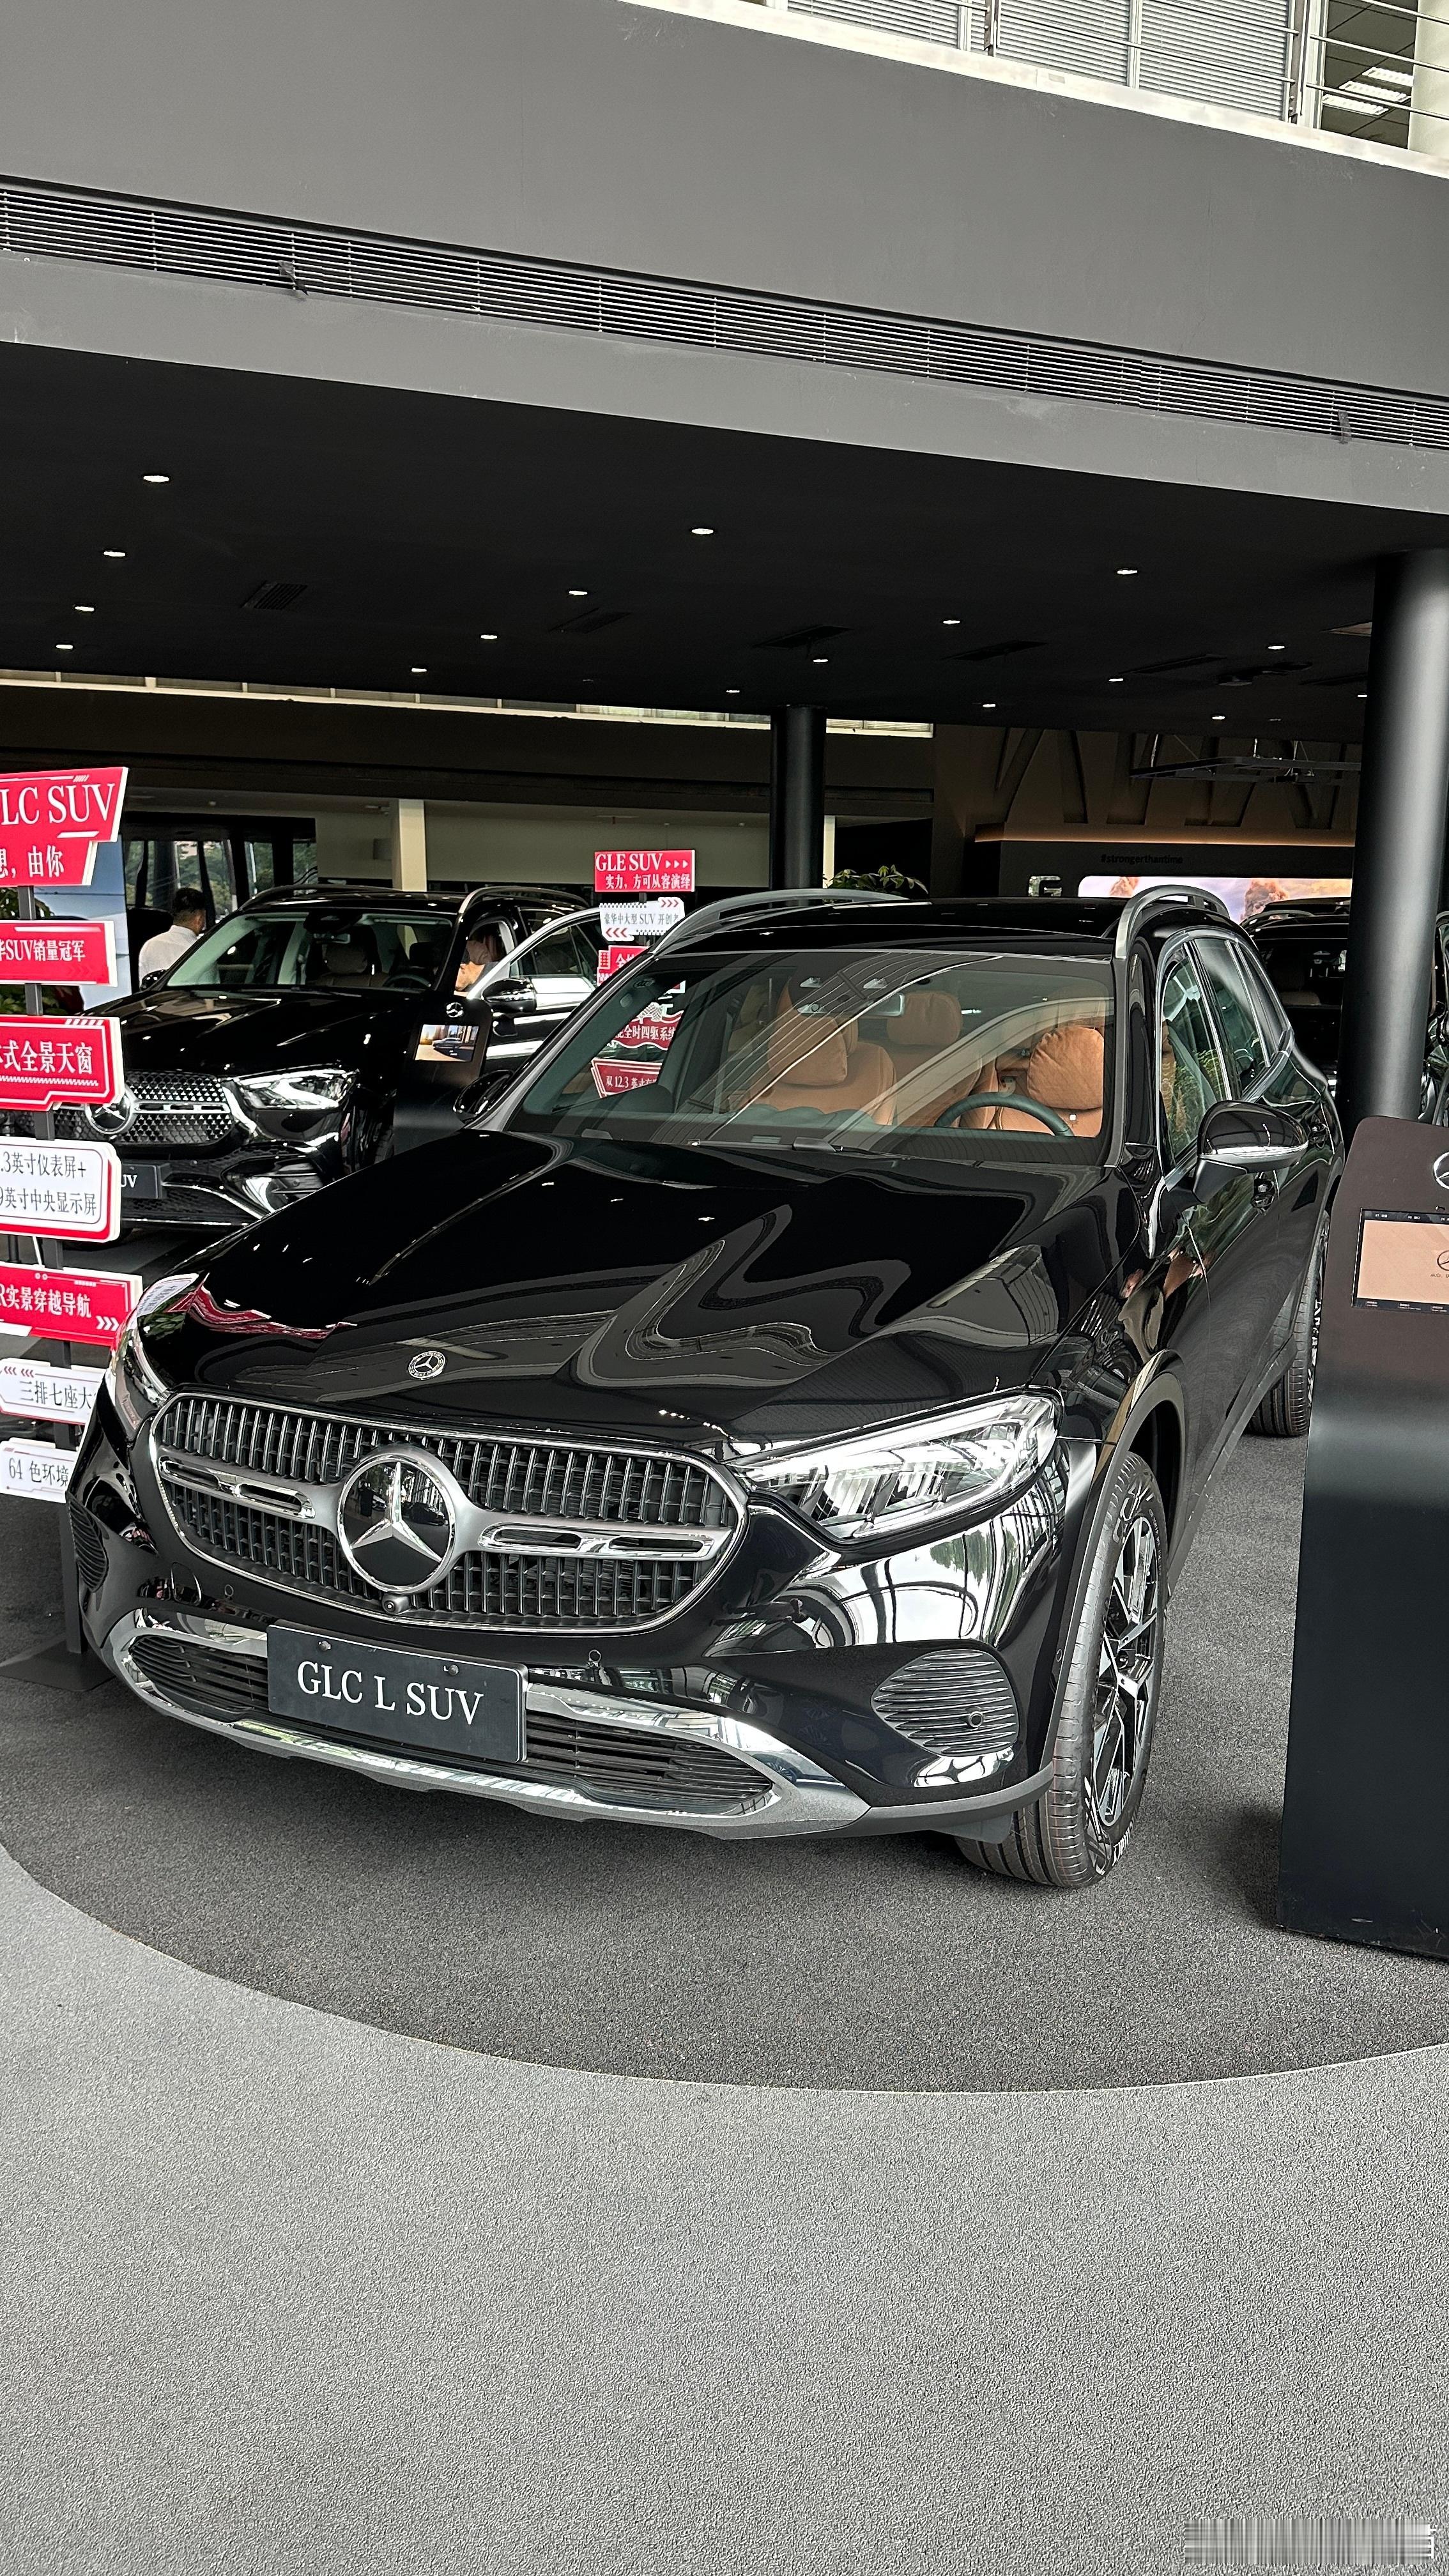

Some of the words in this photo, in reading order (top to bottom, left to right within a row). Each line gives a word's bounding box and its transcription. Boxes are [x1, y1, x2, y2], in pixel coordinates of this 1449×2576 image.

[47, 783, 116, 824] SUV
[595, 854, 626, 871] GLE
[629, 853, 663, 871] SUV
[1101, 854, 1183, 865] #strongerthantime
[606, 873, 691, 890] 实力，方可从容演绎
[640, 914, 656, 924] SUV
[0, 1039, 93, 1075] 式全景天窗
[20, 1381, 96, 1409] 三排七座大
[9, 1458, 23, 1480] 64
[29, 1460, 68, 1487] 色环境
[297, 1660, 363, 1704] GLC
[374, 1675, 395, 1712] L
[406, 1682, 484, 1725] SUV
